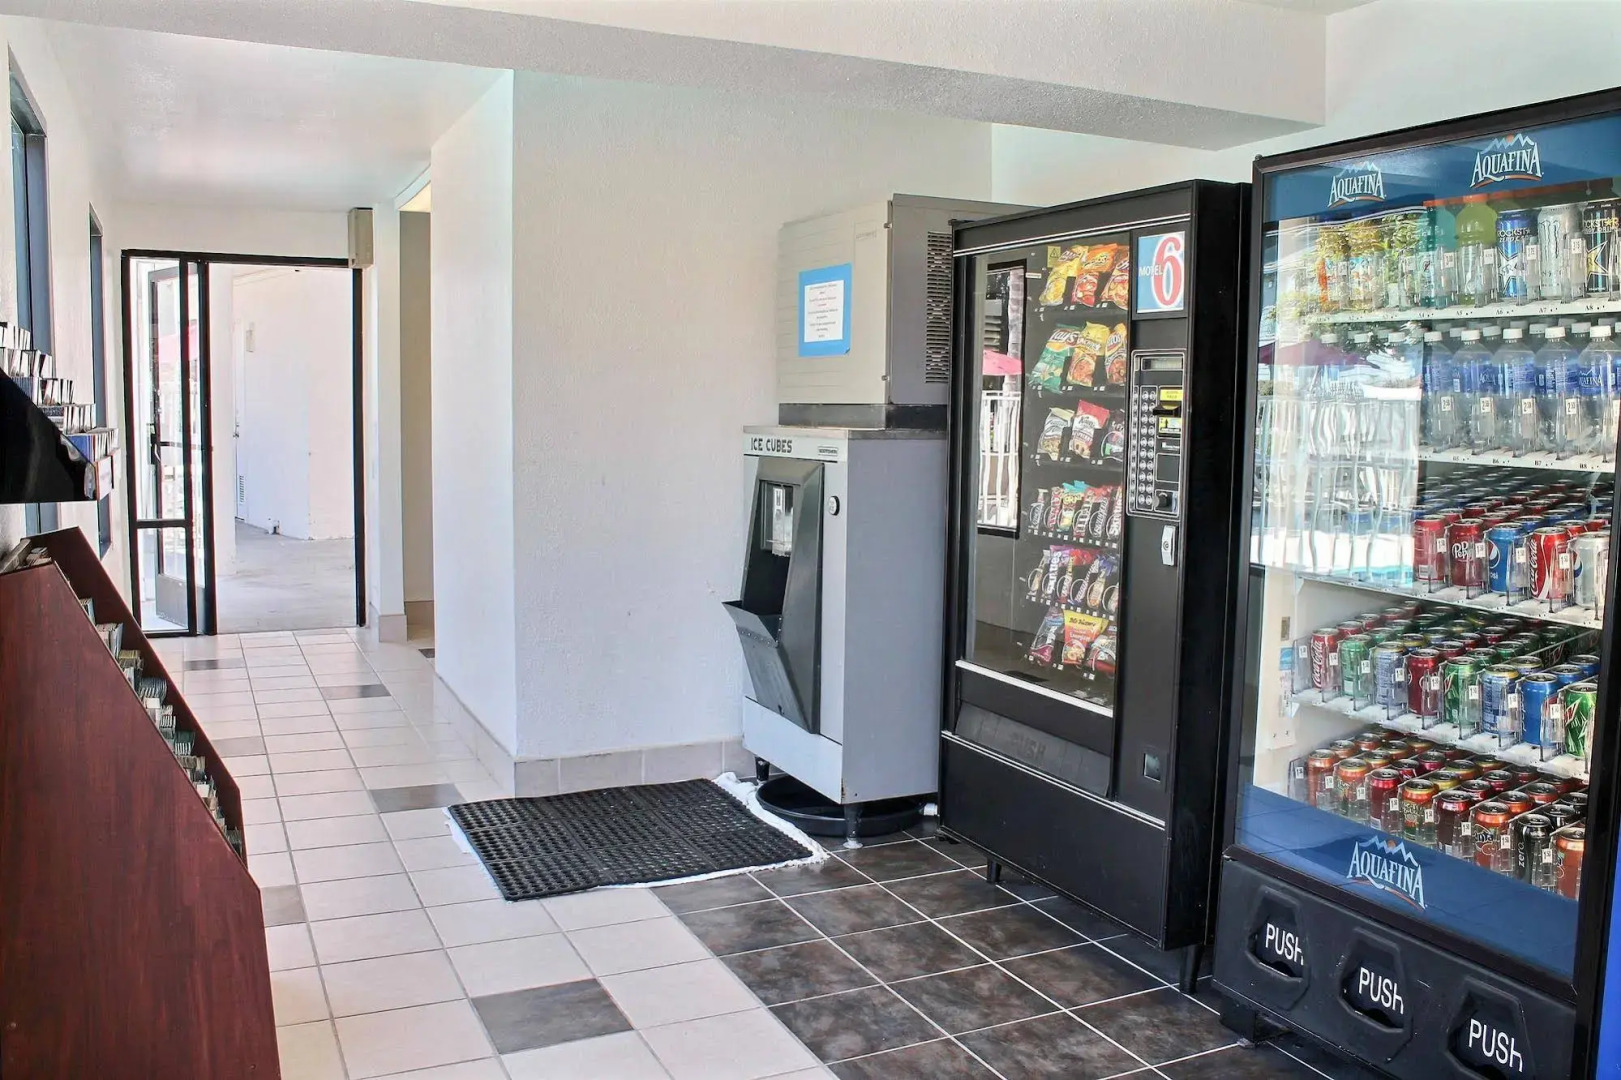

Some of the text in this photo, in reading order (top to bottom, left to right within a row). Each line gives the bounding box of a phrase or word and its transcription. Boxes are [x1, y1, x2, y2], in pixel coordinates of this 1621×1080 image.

[1470, 142, 1543, 187] AQUAFINA
[1326, 170, 1386, 208] AQUAFINA
[1138, 236, 1182, 306] MOTEL 6
[750, 437, 792, 453] ICE CUBES
[1346, 841, 1426, 910] AQUAFINA
[1265, 922, 1304, 966] PUSH
[1358, 966, 1404, 1014] PUSH
[1468, 1018, 1523, 1072] PUSH
